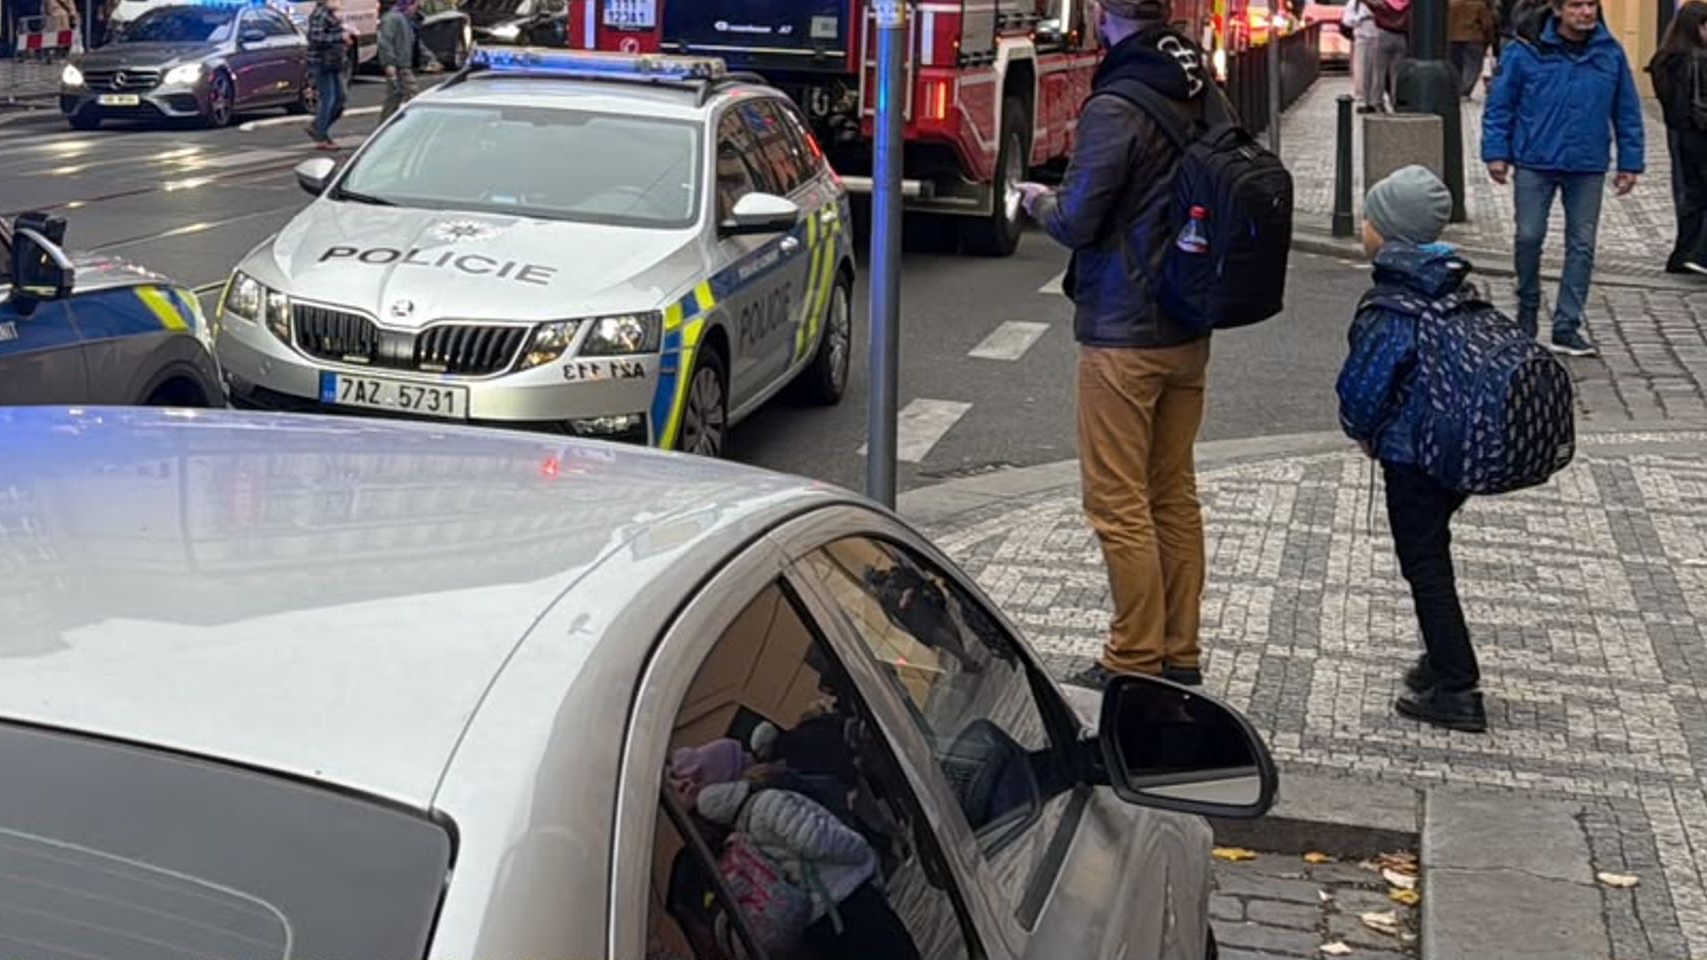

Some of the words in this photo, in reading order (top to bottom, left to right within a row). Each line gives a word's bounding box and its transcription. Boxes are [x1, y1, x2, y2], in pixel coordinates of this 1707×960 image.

[318, 246, 559, 286] POLICIE
[341, 378, 382, 405] 7AZ
[398, 385, 455, 414] 5731
